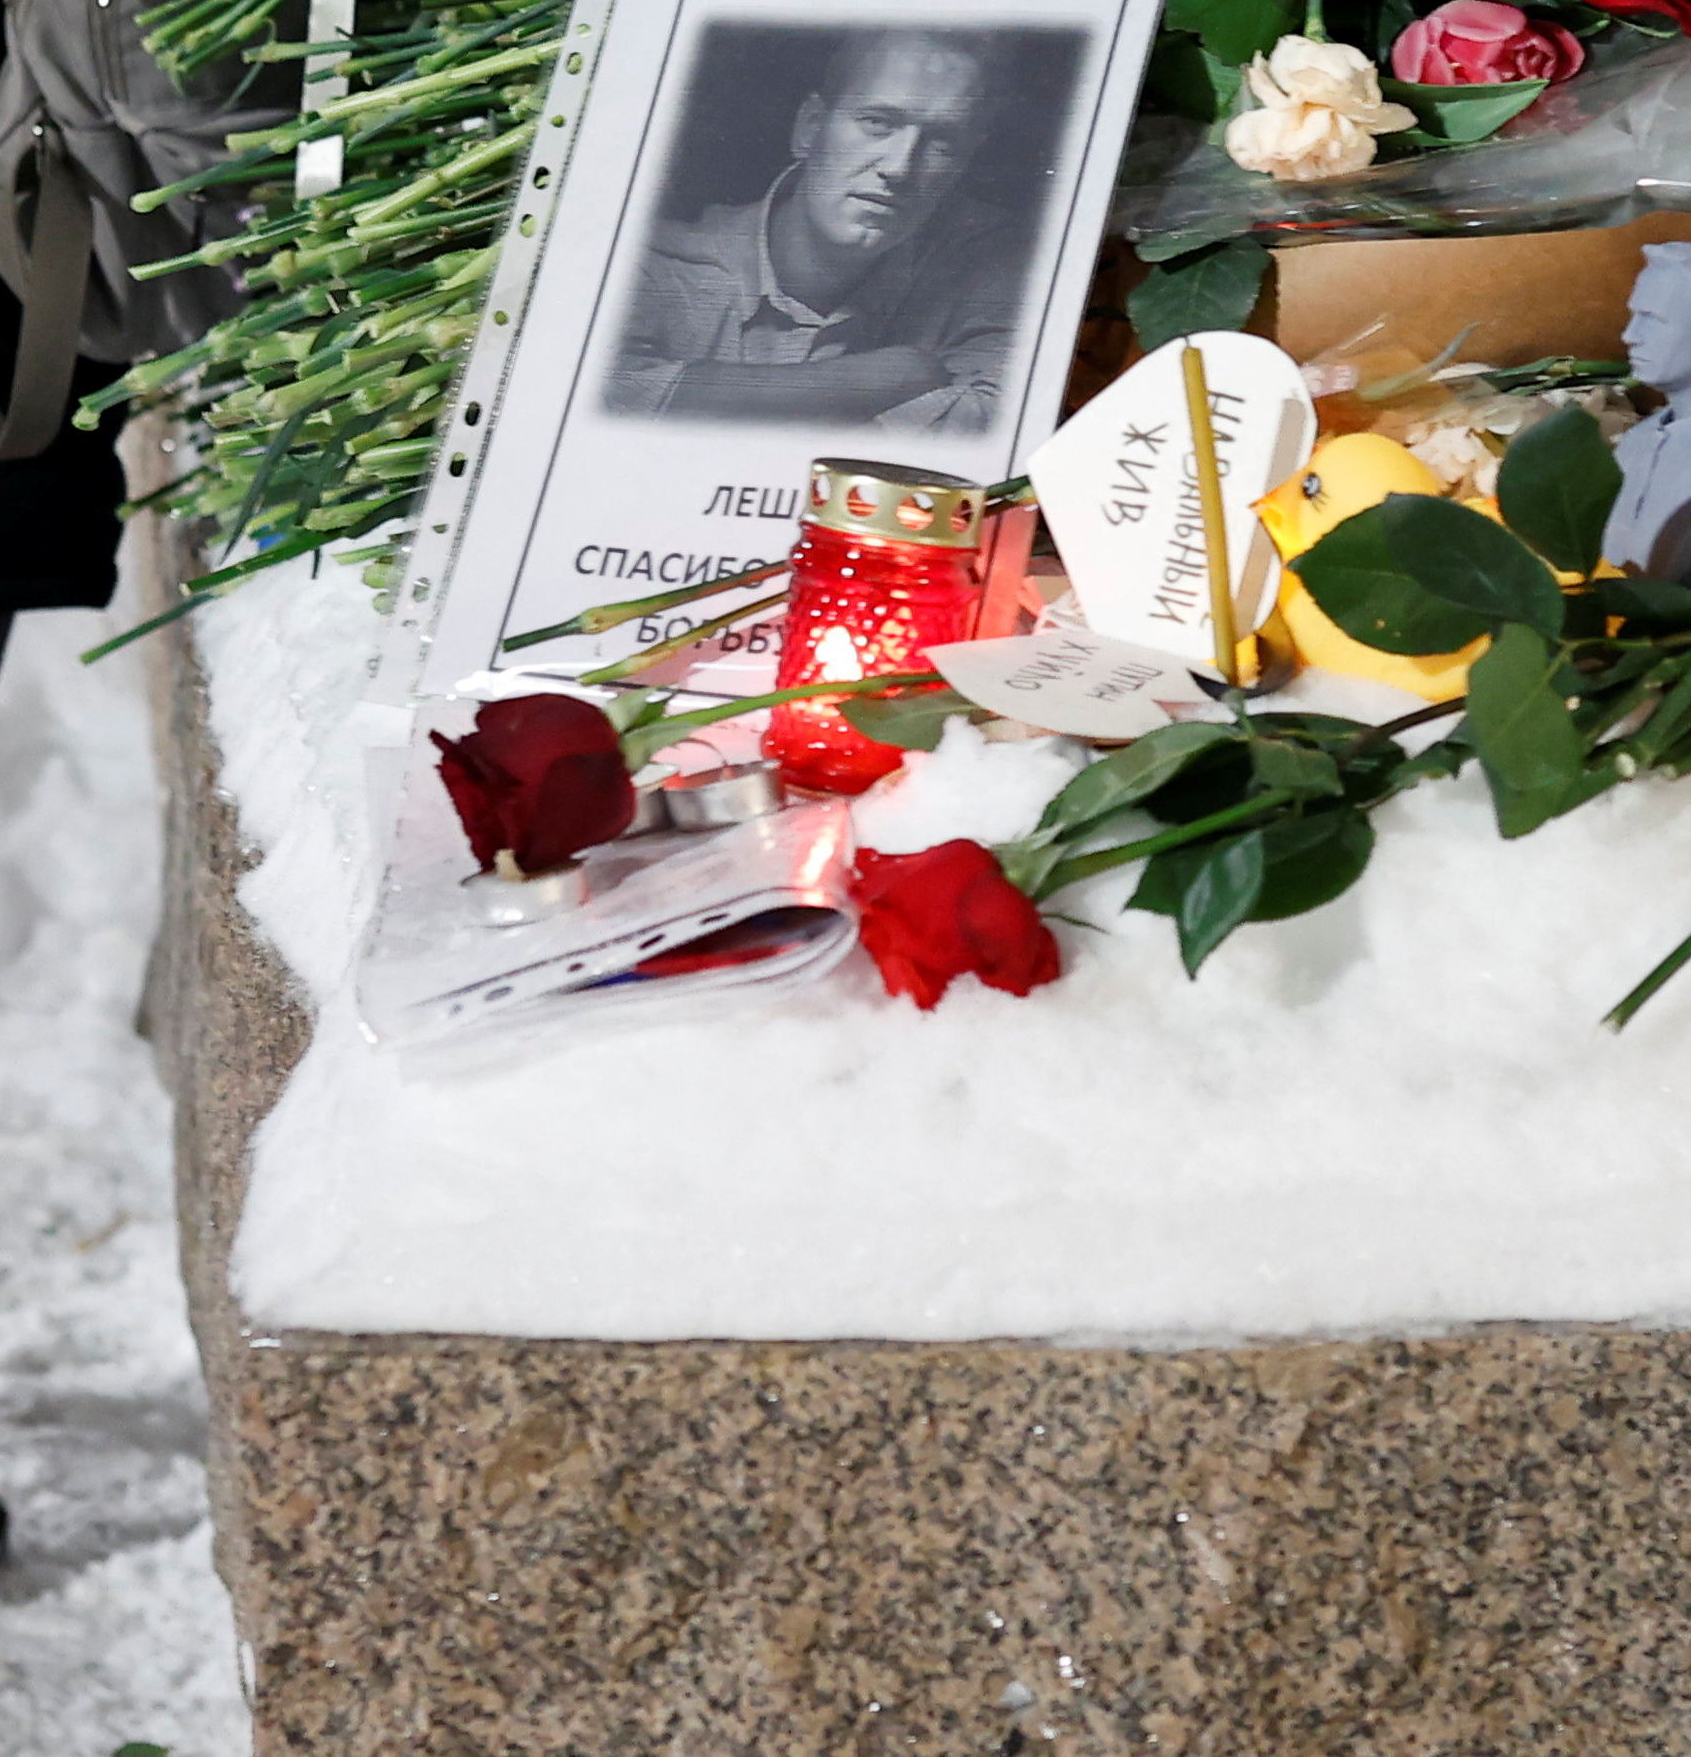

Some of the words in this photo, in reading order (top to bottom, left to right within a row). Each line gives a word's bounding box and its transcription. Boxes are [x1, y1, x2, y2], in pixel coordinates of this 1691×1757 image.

[1101, 422, 1169, 526] ЖИВ
[703, 486, 800, 519] ЛЕШ
[636, 615, 783, 656] БОЬБ
